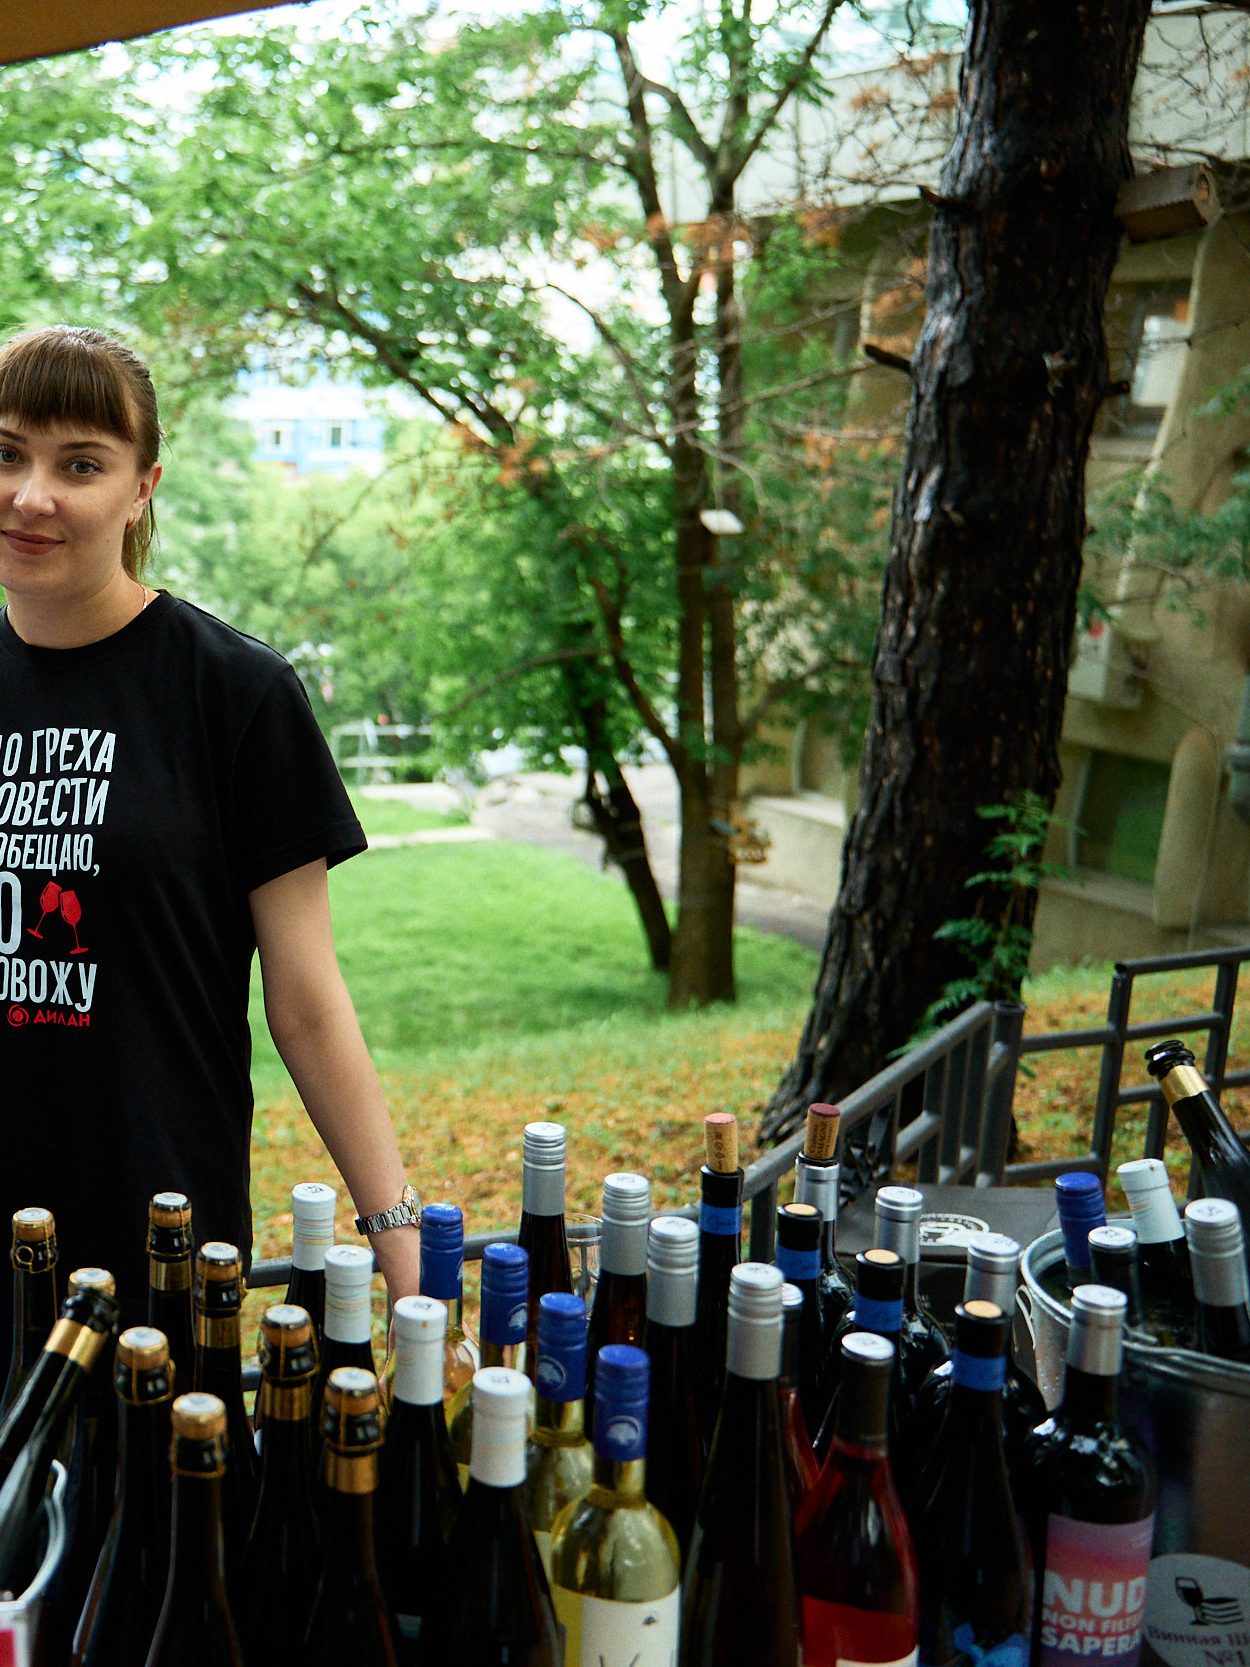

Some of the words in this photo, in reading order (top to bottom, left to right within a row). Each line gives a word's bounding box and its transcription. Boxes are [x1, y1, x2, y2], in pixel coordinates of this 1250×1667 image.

[29, 727, 117, 775] ГРЕХА
[33, 1008, 91, 1028] ДИЛАН
[1042, 1608, 1095, 1633] NON
